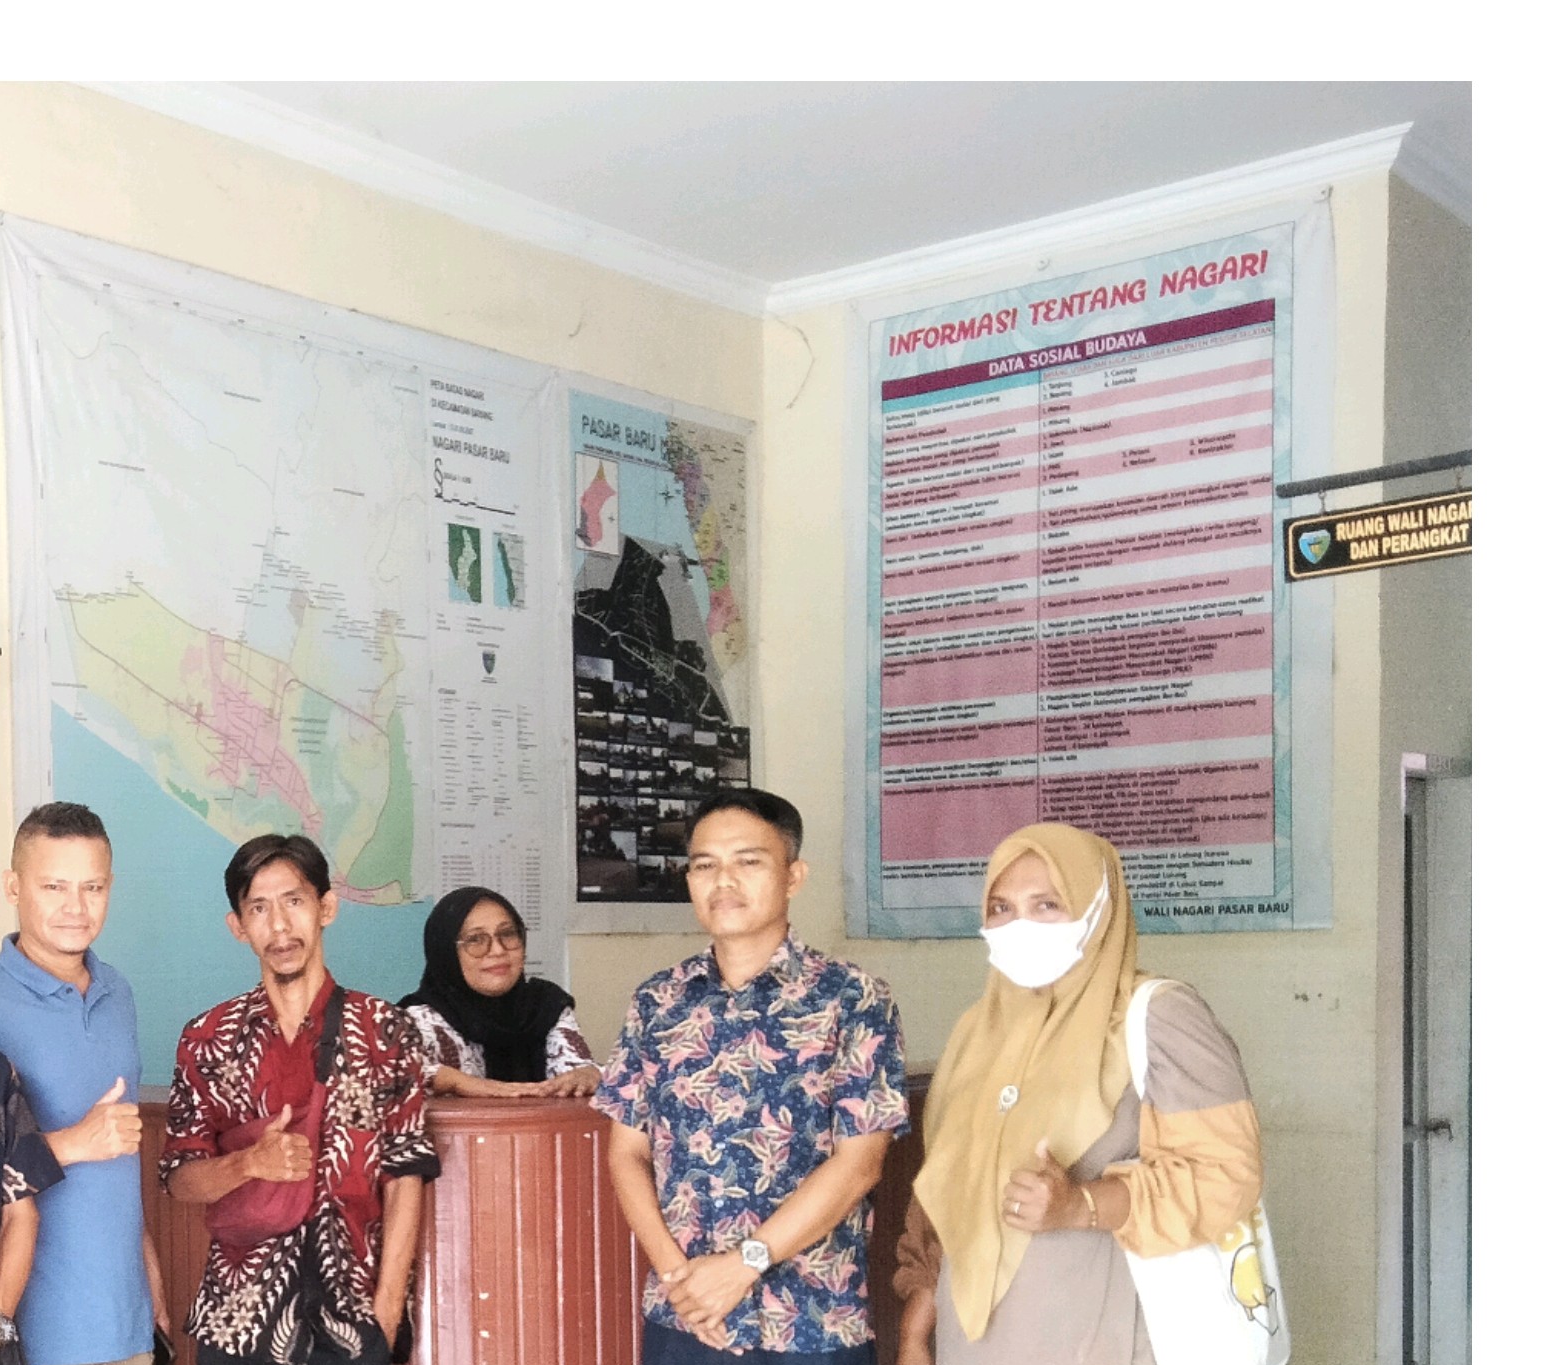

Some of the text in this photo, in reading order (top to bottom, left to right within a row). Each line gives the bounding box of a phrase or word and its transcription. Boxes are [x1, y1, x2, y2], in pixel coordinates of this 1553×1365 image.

[888, 250, 1268, 357] INFORMASI TENTANG NAGARI
[988, 330, 1147, 377] DATA SOSIAL BUDAYA
[582, 414, 621, 442] PASAR
[625, 426, 656, 452] BARU
[1336, 517, 1385, 541] RUANG
[1388, 509, 1424, 532] WALI
[1350, 523, 1470, 560] DAN PERANGKAT
[1144, 902, 1290, 917] WALI NAGARI PASAR BARU
